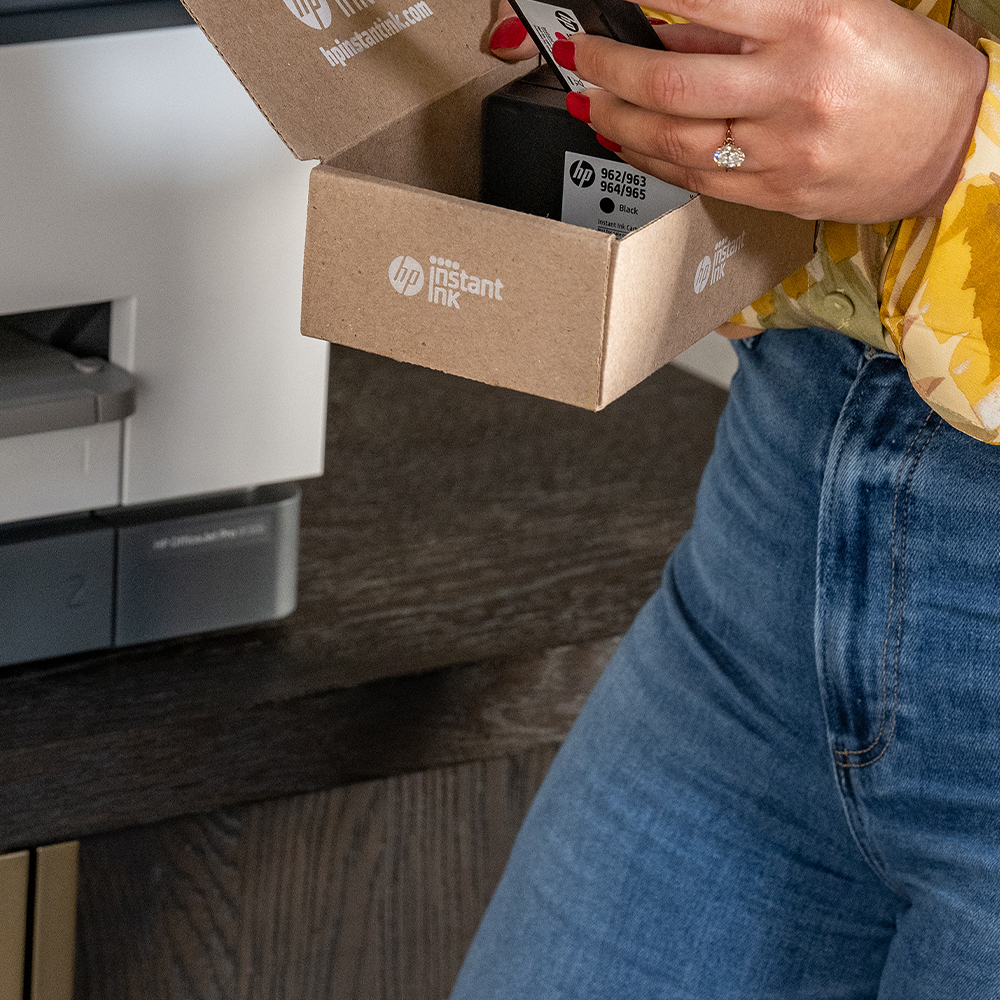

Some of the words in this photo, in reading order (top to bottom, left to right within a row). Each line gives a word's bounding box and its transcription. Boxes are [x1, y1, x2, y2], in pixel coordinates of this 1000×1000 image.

[319, 0, 434, 67] hpinstantink.com
[569, 160, 596, 188] hp
[601, 168, 647, 187] 962/963
[600, 181, 646, 200] 964/965
[619, 204, 639, 216] Black
[428, 255, 504, 301] instant
